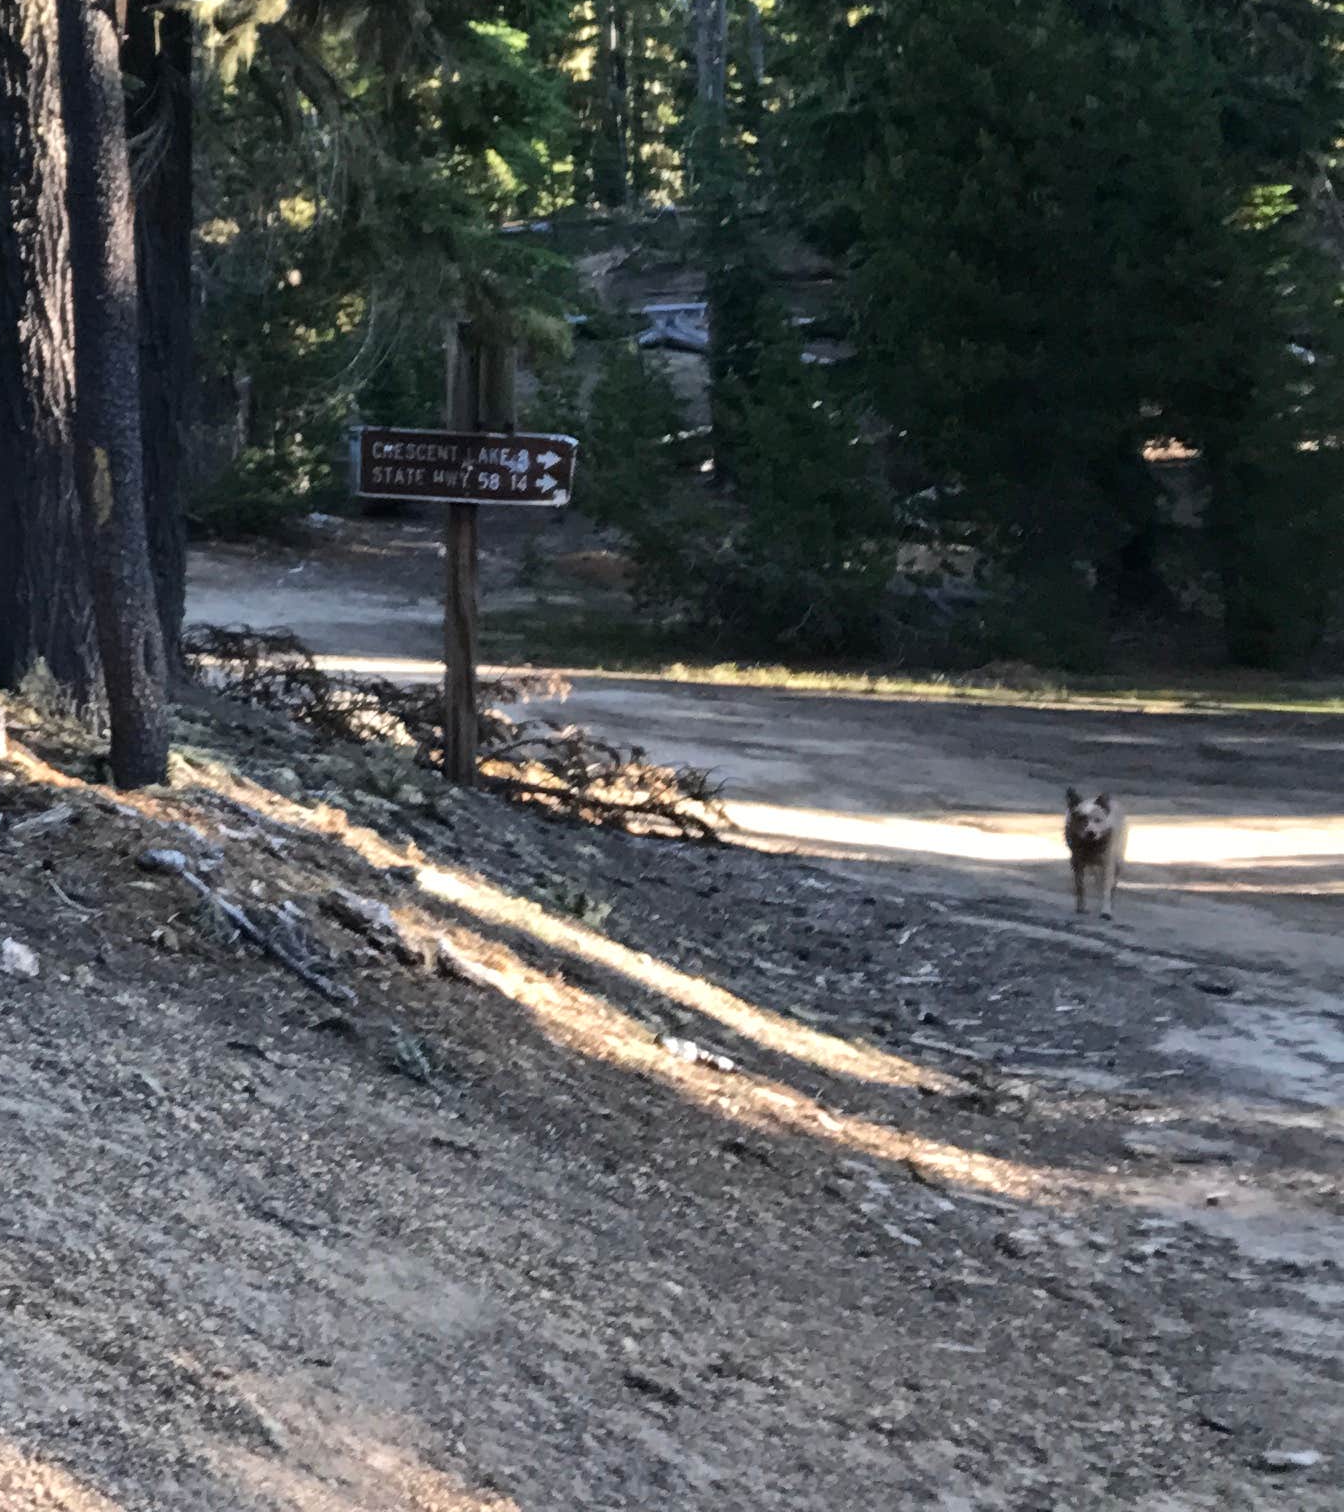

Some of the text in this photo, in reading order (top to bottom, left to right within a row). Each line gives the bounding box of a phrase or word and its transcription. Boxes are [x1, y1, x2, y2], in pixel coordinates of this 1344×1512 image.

[372, 441, 458, 462] CRESCENT
[466, 445, 512, 466] LAKE
[372, 466, 425, 486] STATE
[478, 471, 500, 490] 58
[511, 473, 528, 491] 14
